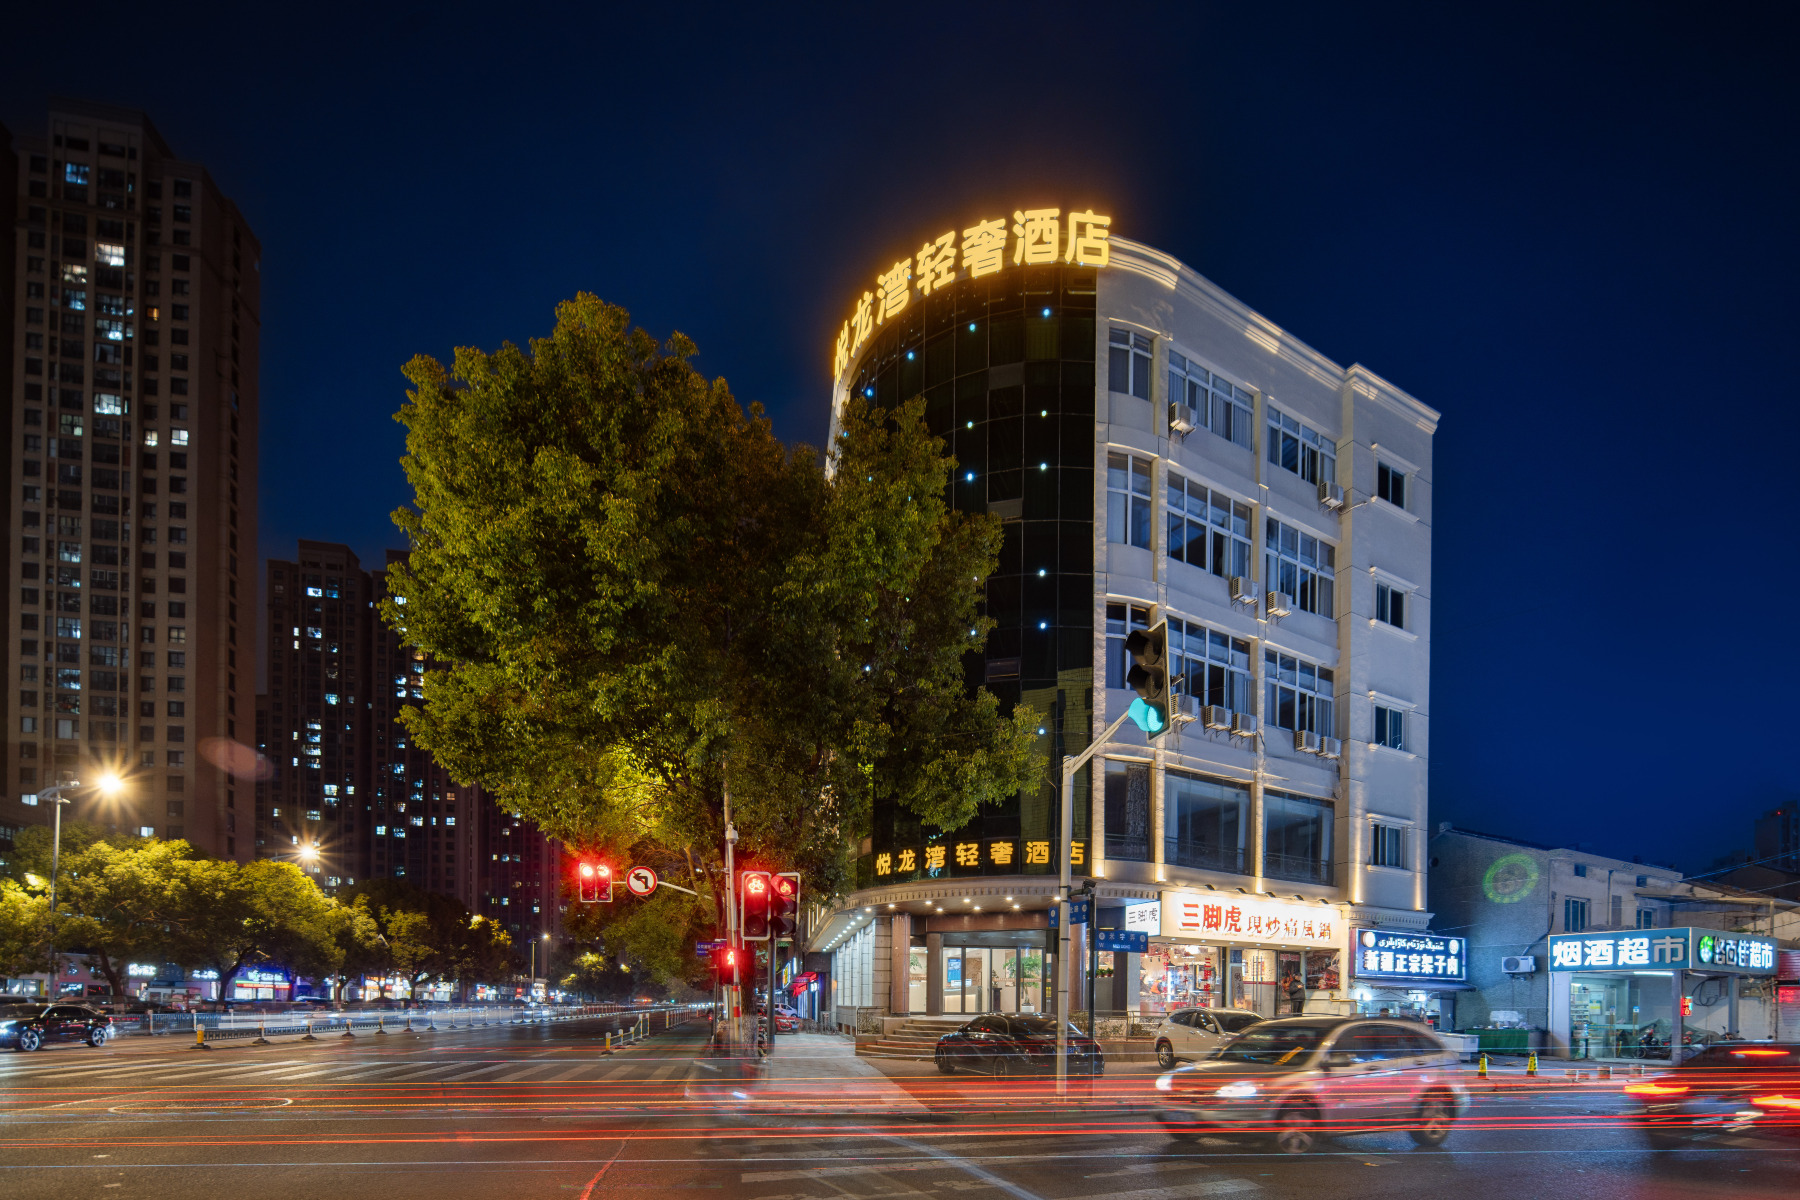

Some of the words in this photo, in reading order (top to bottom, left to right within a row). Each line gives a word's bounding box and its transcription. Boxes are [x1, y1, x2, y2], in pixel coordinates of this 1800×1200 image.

[834, 207, 1112, 383] 悦龙湾轻奢酒店
[1128, 907, 1158, 924] 三脚虎
[1180, 902, 1242, 933] 三脚虎
[1364, 949, 1458, 975] 新疆正宗架子肉
[1552, 936, 1685, 967] 烟酒超市
